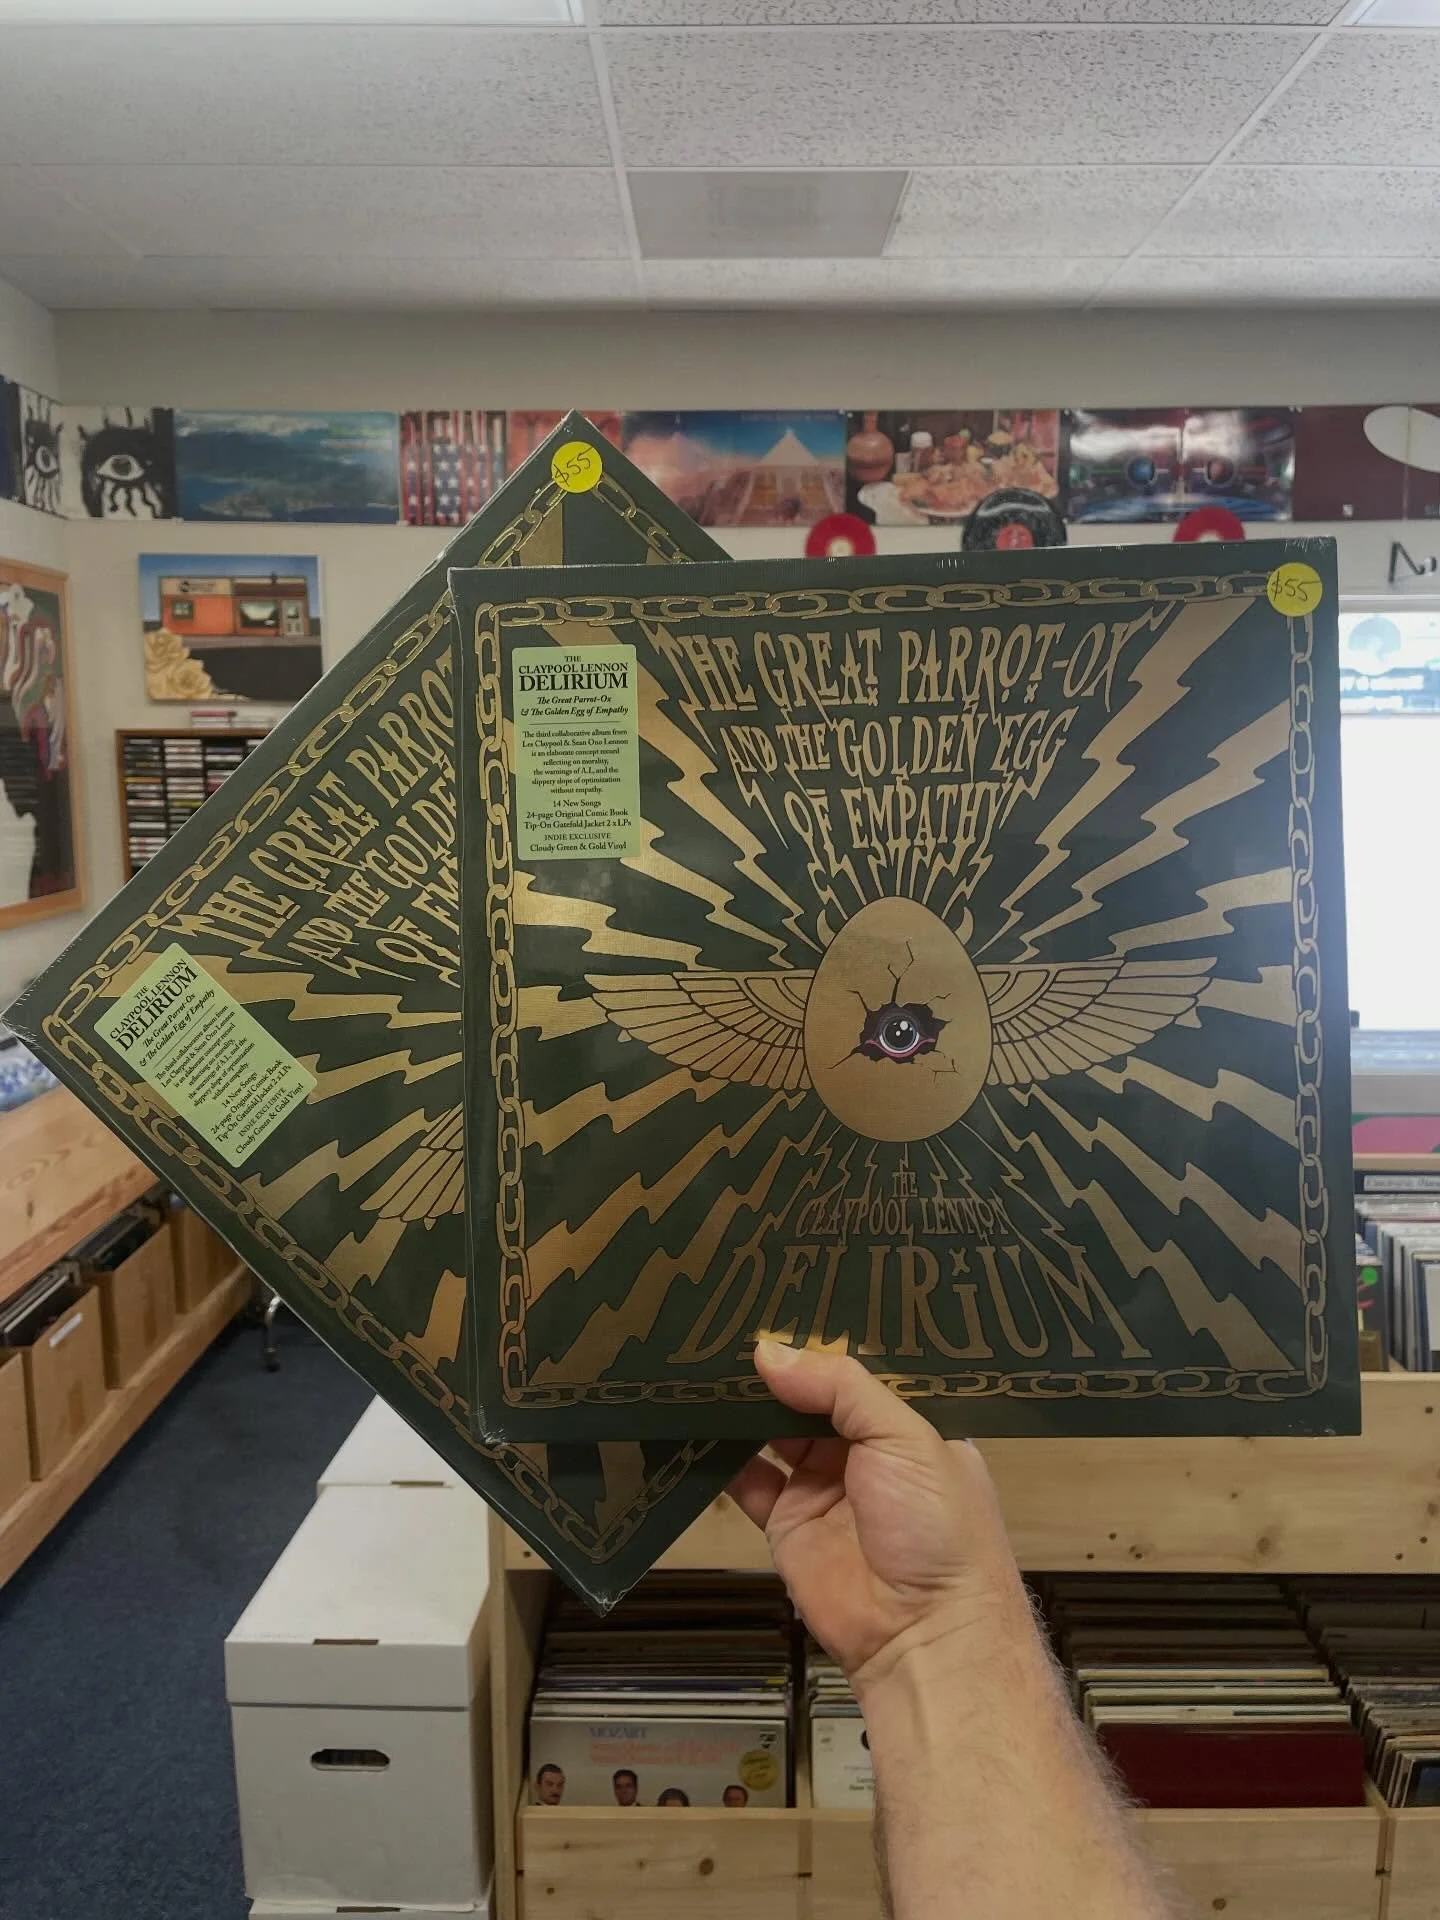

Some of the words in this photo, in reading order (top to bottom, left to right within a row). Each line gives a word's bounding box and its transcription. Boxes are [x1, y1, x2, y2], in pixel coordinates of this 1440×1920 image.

[553, 446, 593, 487] $55
[1271, 571, 1321, 601] $55
[518, 663, 578, 674] CLAYPOOL
[580, 661, 628, 672] LENNON
[518, 671, 628, 692] DELIRIUM
[645, 621, 758, 712] THE
[753, 627, 882, 708] GREAT
[898, 615, 1152, 711] PARROT-OX
[520, 708, 529, 716] &
[530, 707, 543, 716] The
[544, 707, 570, 715] Golden
[570, 706, 584, 716] Egg
[586, 706, 594, 716] of
[595, 705, 628, 716] Empathy
[536, 696, 550, 704] The
[551, 695, 572, 704] Great
[573, 693, 612, 703] Parrot-Ox
[720, 726, 778, 780] AND
[776, 721, 832, 771] THE
[831, 713, 988, 778] GOLDEN
[990, 706, 1080, 778] EGG
[525, 810, 553, 820] 24-page
[554, 809, 583, 819] Original
[584, 808, 608, 817] Comic
[609, 807, 629, 816] Book
[562, 799, 578, 807] New
[580, 798, 601, 808] Songs
[784, 788, 834, 856] OF
[840, 780, 1010, 850] EMPATHY
[523, 820, 551, 831] Tip-On
[552, 819, 583, 828] Gatefold
[583, 819, 605, 829] Jacket
[617, 818, 631, 826] LPs
[544, 833, 568, 841] INDIE
[568, 832, 612, 840] EXCLUSIVE
[163, 873, 301, 948] THE
[249, 770, 380, 890] GREAT
[529, 843, 555, 853] Cloudy
[556, 842, 577, 851] Green
[578, 842, 586, 850] &
[587, 841, 606, 850] Gold
[607, 841, 627, 851] Vinyl
[286, 917, 357, 963] AND
[324, 868, 391, 926] THE
[376, 913, 461, 968] OF
[109, 995, 154, 1039] CLAYPOOL
[150, 958, 187, 997] LENNON
[115, 965, 199, 1052] DELIRIUM
[134, 985, 149, 1000] THE
[142, 1036, 154, 1048] The
[152, 1020, 169, 1038] Great
[167, 993, 196, 1023] Parrot-Ox
[145, 1048, 157, 1060] The
[155, 1029, 178, 1051] Golden
[172, 1019, 187, 1033] Egg
[189, 989, 215, 1015] Empathy
[210, 1112, 233, 1135] 24-page
[230, 1089, 254, 1114] Original
[250, 1073, 270, 1092] Comic
[266, 1059, 283, 1076] Book
[215, 1121, 239, 1142] Tip-On
[235, 1097, 260, 1122] Gatefold
[255, 1083, 274, 1103] Jacket
[278, 1065, 292, 1077] LPs
[221, 1099, 231, 1109] 14
[227, 1087, 242, 1102] New
[239, 1071, 258, 1089] Songs
[235, 1134, 256, 1154] Cloudy
[253, 1118, 272, 1136] Green
[274, 1096, 290, 1113] Gold
[286, 1082, 304, 1099] Vinyl
[238, 1118, 257, 1137] INDIE
[254, 1087, 287, 1120] EXCLUSIVE
[890, 1170, 918, 1197] THE
[795, 1197, 914, 1238] CLAYPOOL
[919, 1196, 1010, 1237] LENNON
[666, 1244, 1153, 1364] DELIRIUM
[588, 1727, 648, 1739] MOZART
